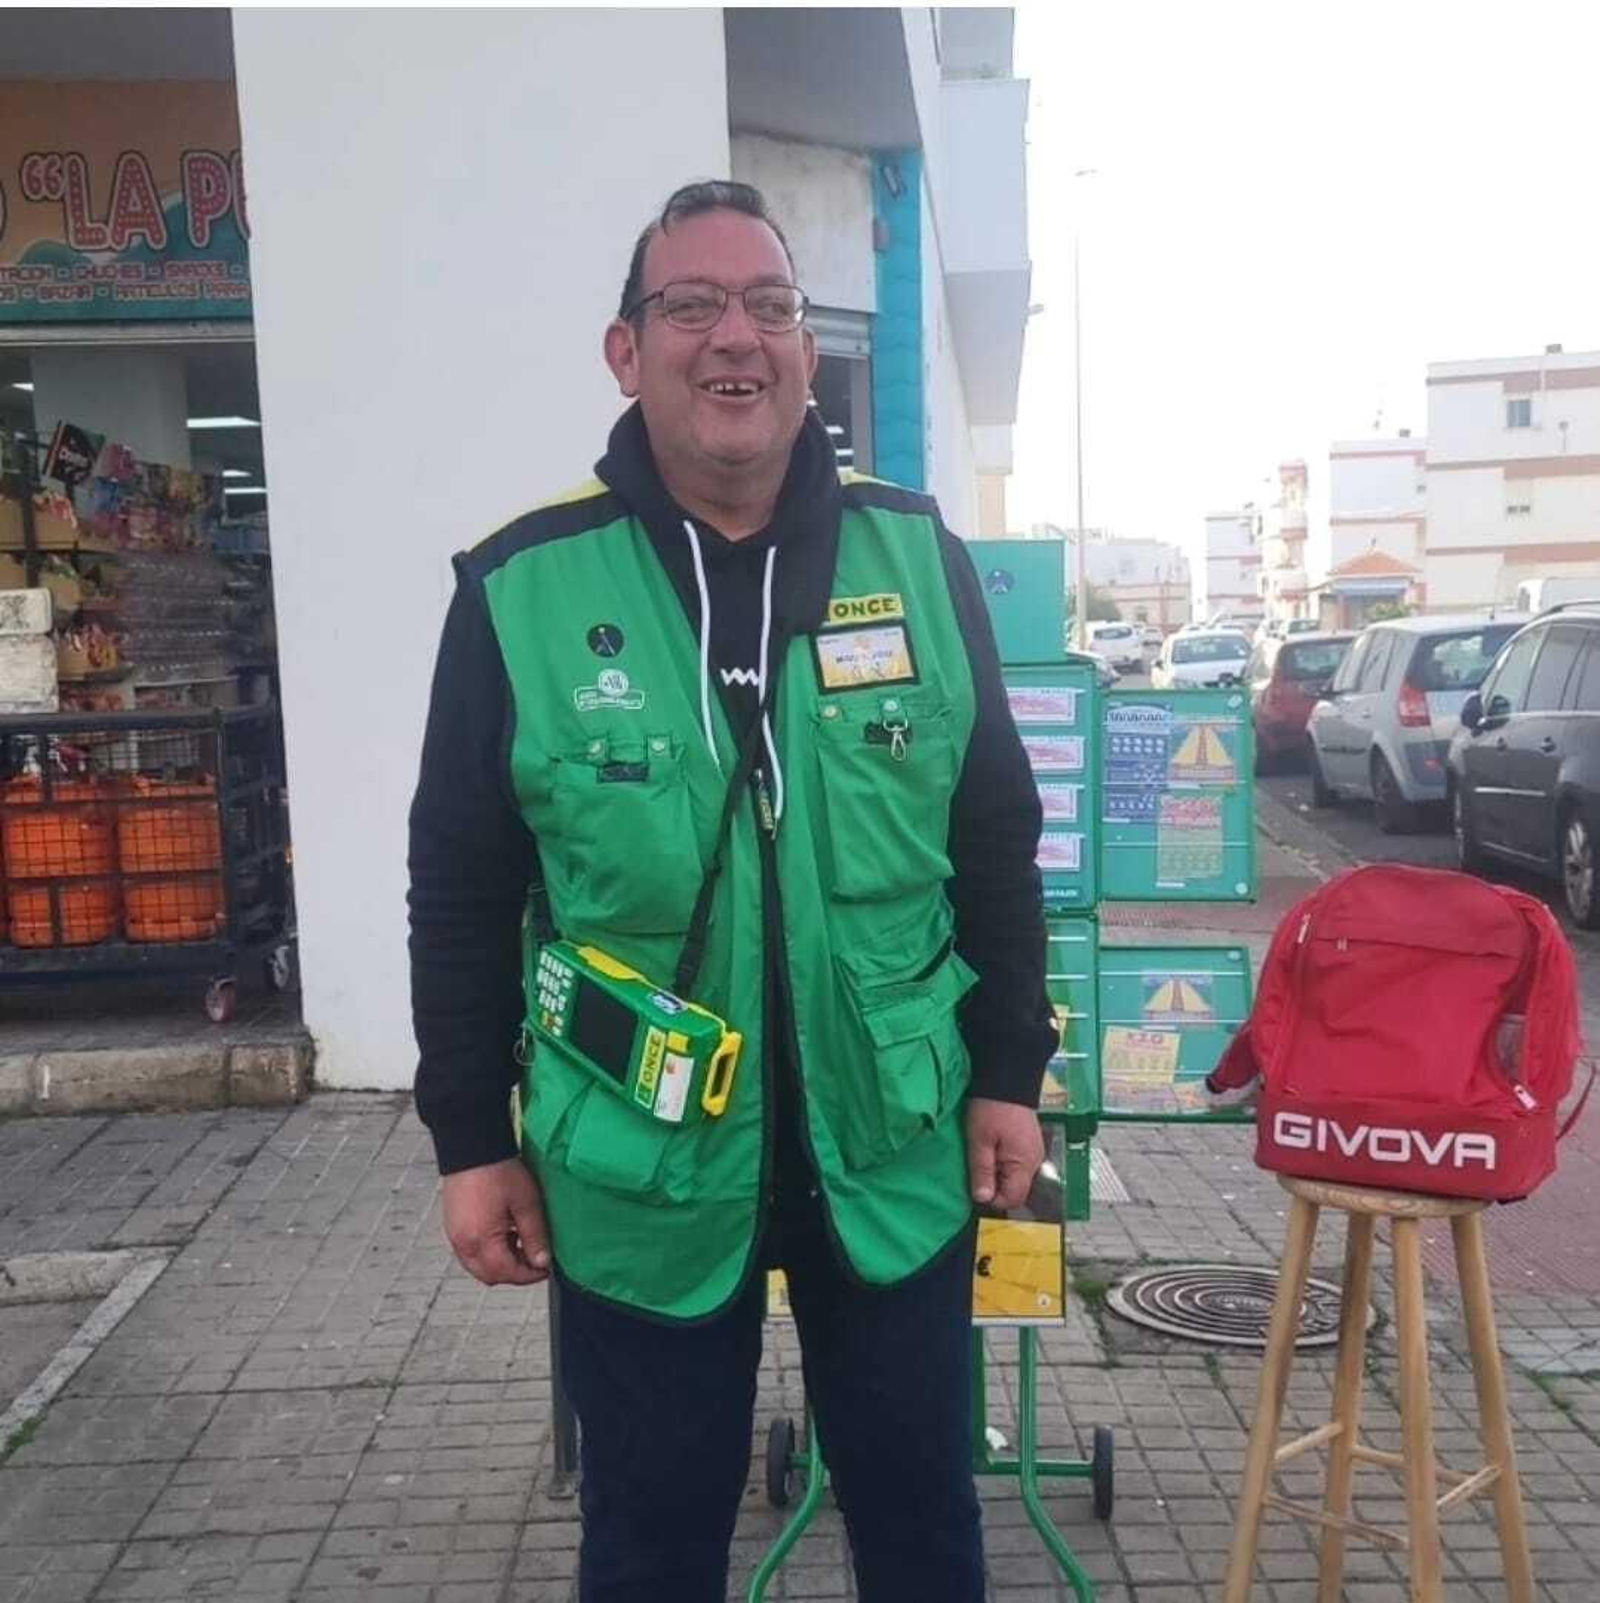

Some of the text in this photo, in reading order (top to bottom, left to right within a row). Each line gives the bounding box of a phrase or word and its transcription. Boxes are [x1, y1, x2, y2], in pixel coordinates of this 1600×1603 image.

[833, 598, 897, 618] ONCE
[643, 1031, 662, 1083] ONCE
[1274, 1111, 1496, 1170] GIVOVA
